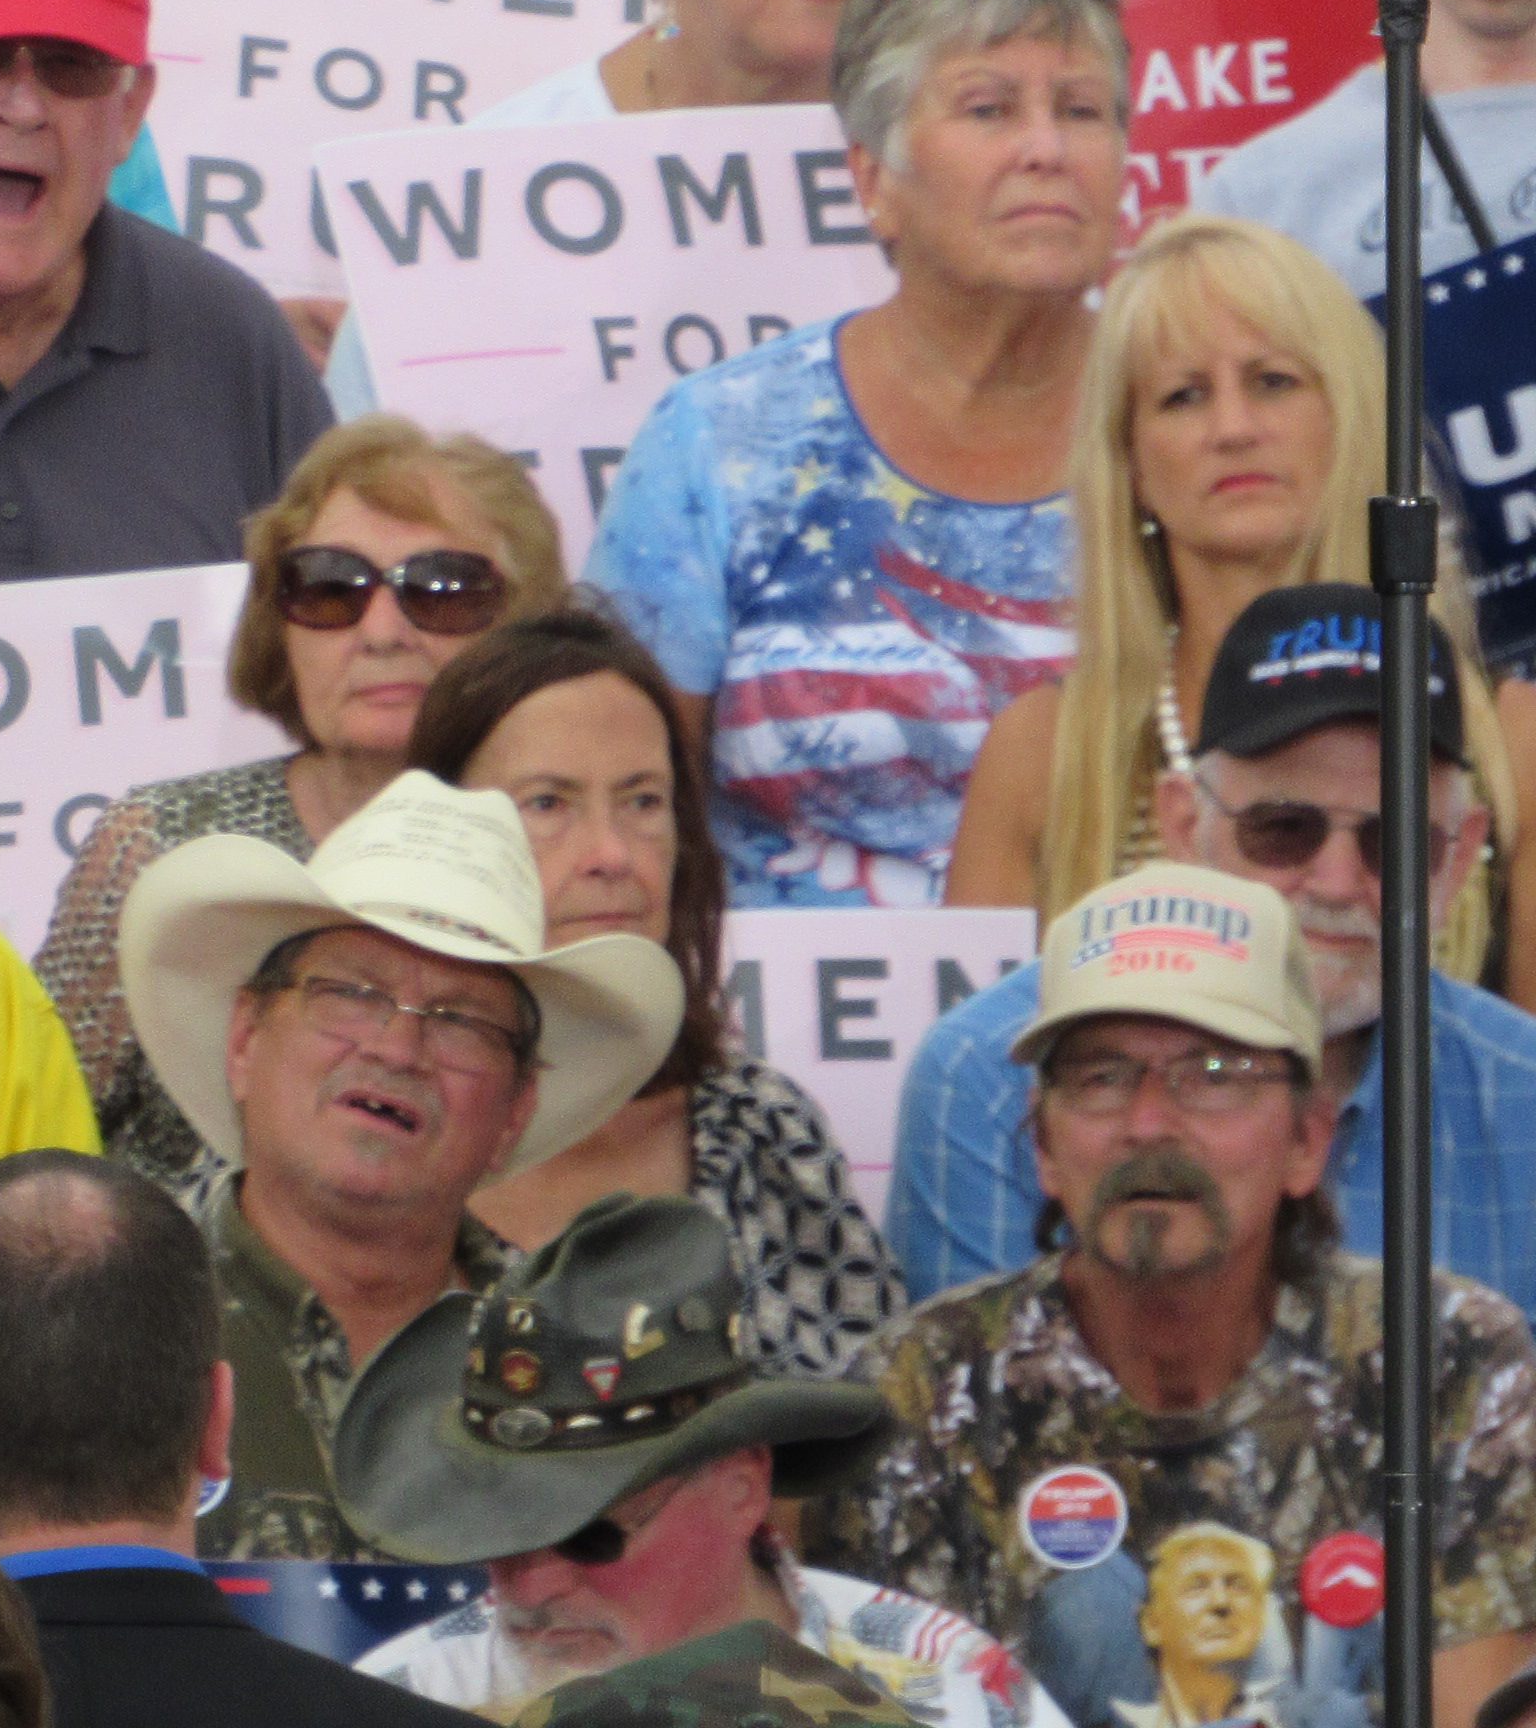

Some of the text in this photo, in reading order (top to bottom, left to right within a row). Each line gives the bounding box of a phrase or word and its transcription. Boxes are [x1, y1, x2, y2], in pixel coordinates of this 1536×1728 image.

[237, 34, 470, 128] FOR
[1079, 894, 1254, 944] Trump
[1105, 950, 1197, 976] 2016
